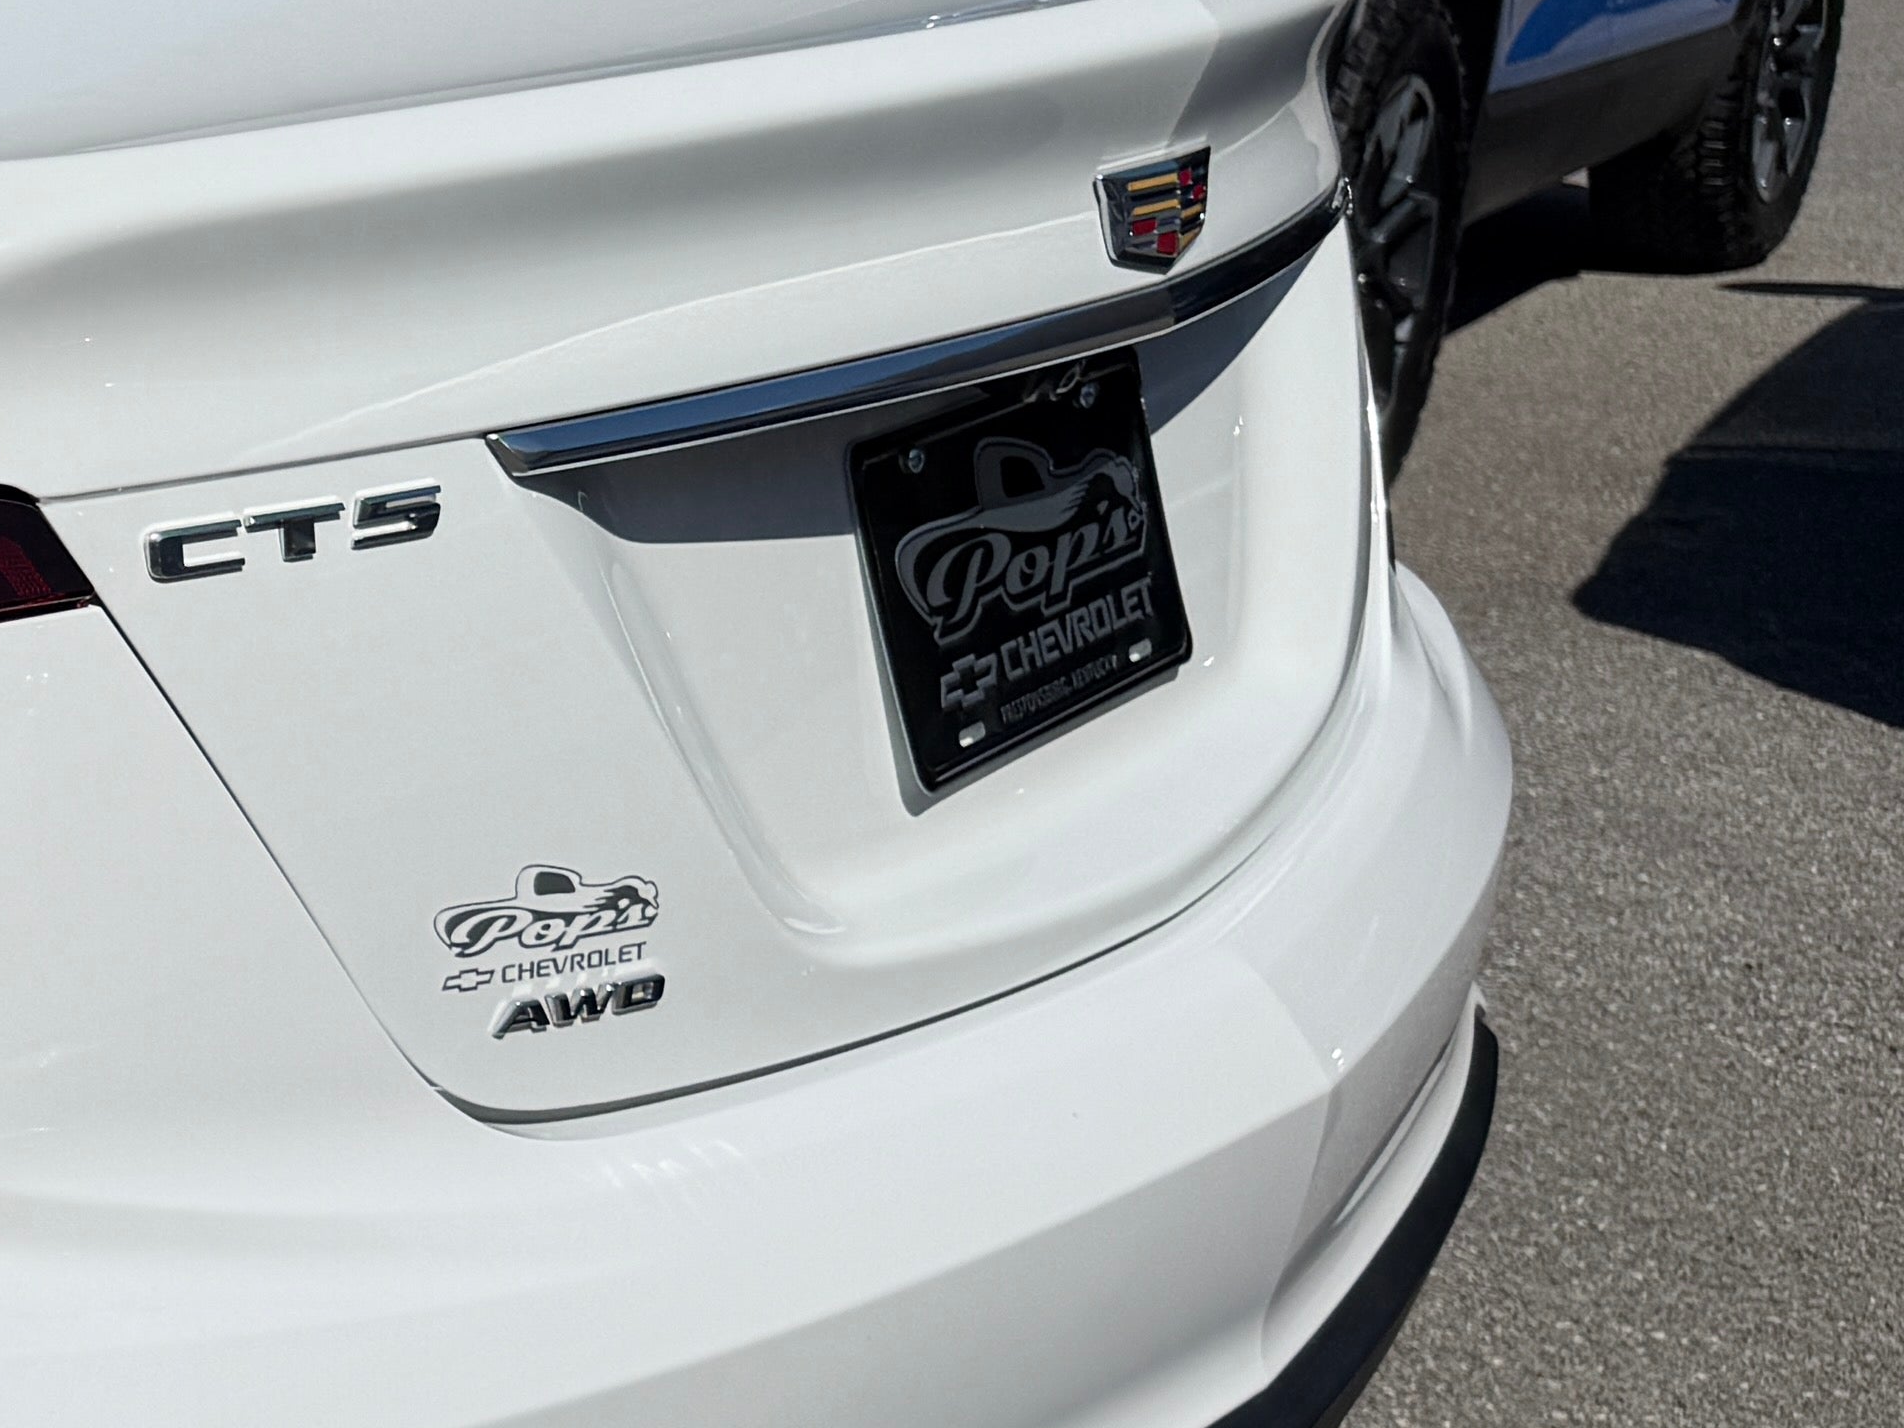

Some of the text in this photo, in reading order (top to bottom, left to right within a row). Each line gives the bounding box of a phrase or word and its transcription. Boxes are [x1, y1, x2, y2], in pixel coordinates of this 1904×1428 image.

[144, 477, 442, 583] CT5
[1000, 575, 1154, 681] CHEVROLET
[501, 941, 647, 984] CHEVROLET
[491, 973, 666, 1040] AWD
